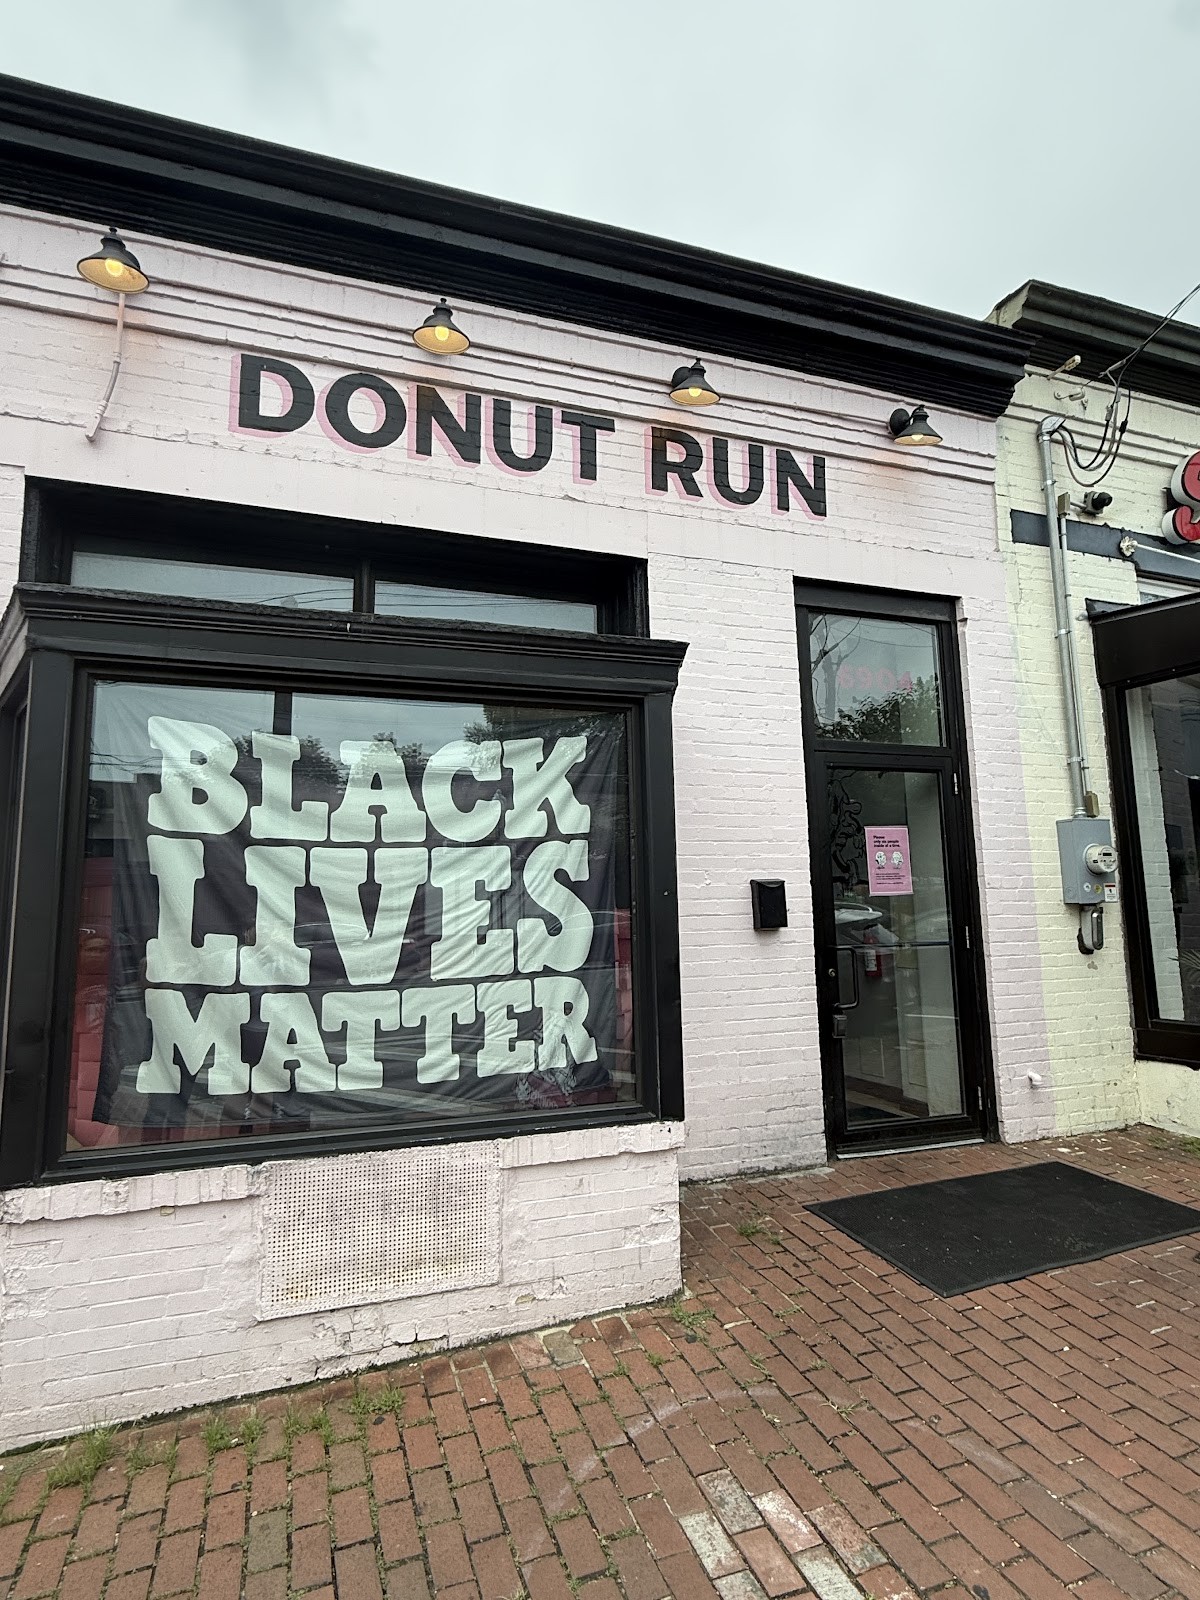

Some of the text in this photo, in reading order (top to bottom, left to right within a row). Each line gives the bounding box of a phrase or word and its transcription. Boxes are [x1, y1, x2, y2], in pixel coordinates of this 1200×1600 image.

[230, 353, 827, 520] DONUT RUN
[147, 716, 591, 842] BLACK
[146, 834, 594, 986] LIVES
[136, 977, 598, 1095] MATTER
